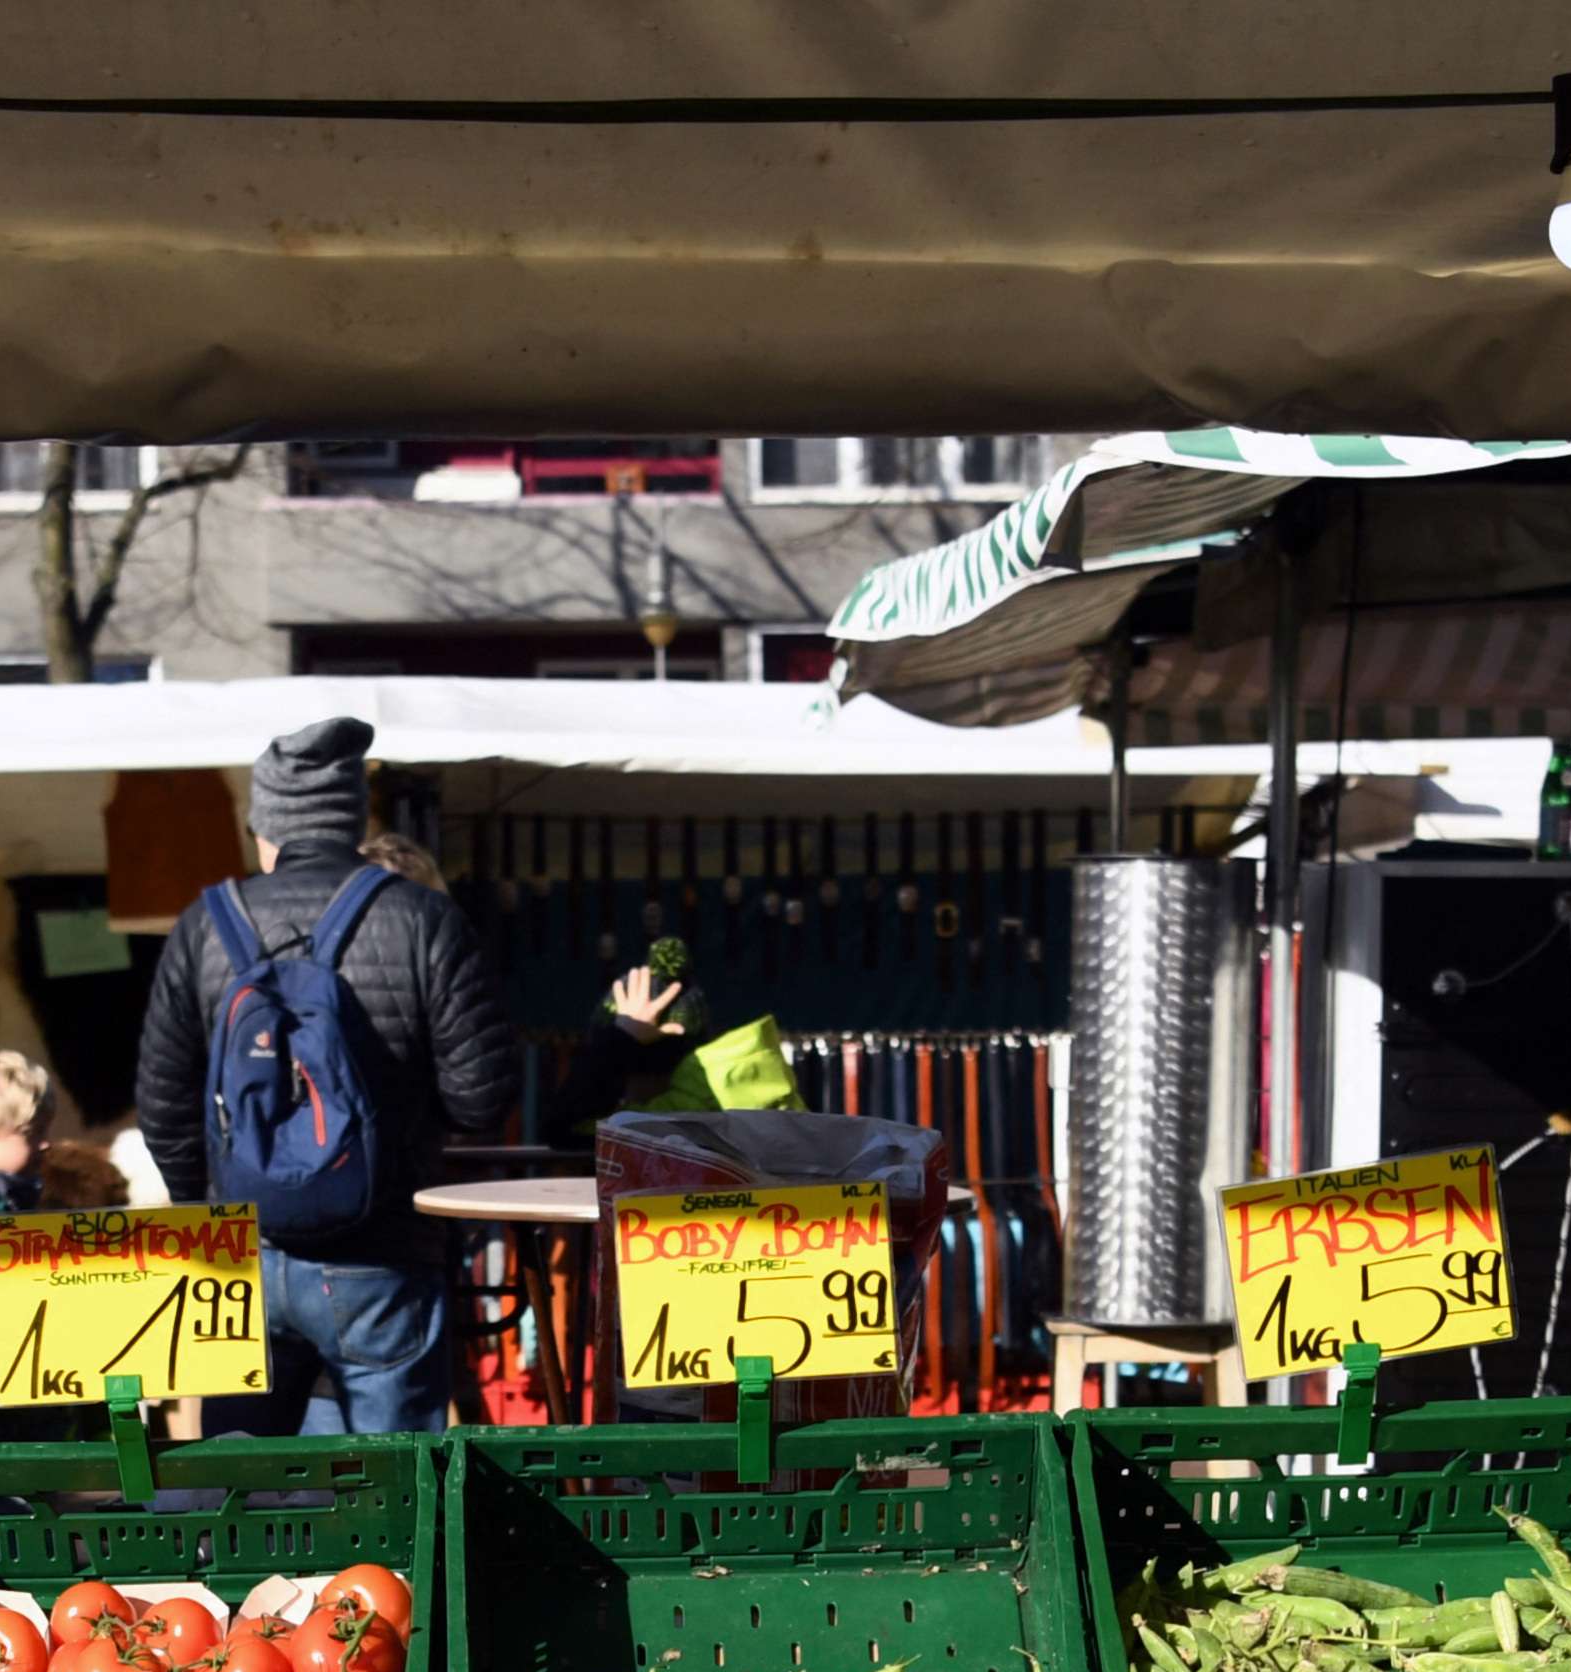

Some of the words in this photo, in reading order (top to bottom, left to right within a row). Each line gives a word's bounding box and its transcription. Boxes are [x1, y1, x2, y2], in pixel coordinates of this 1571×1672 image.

[1296, 1162, 1399, 1196] ITALIEN
[681, 1192, 760, 1213] SENEGAL
[68, 1210, 128, 1237] BIO
[618, 1208, 747, 1264] BOBY
[1230, 1159, 1496, 1283] ERBSEN
